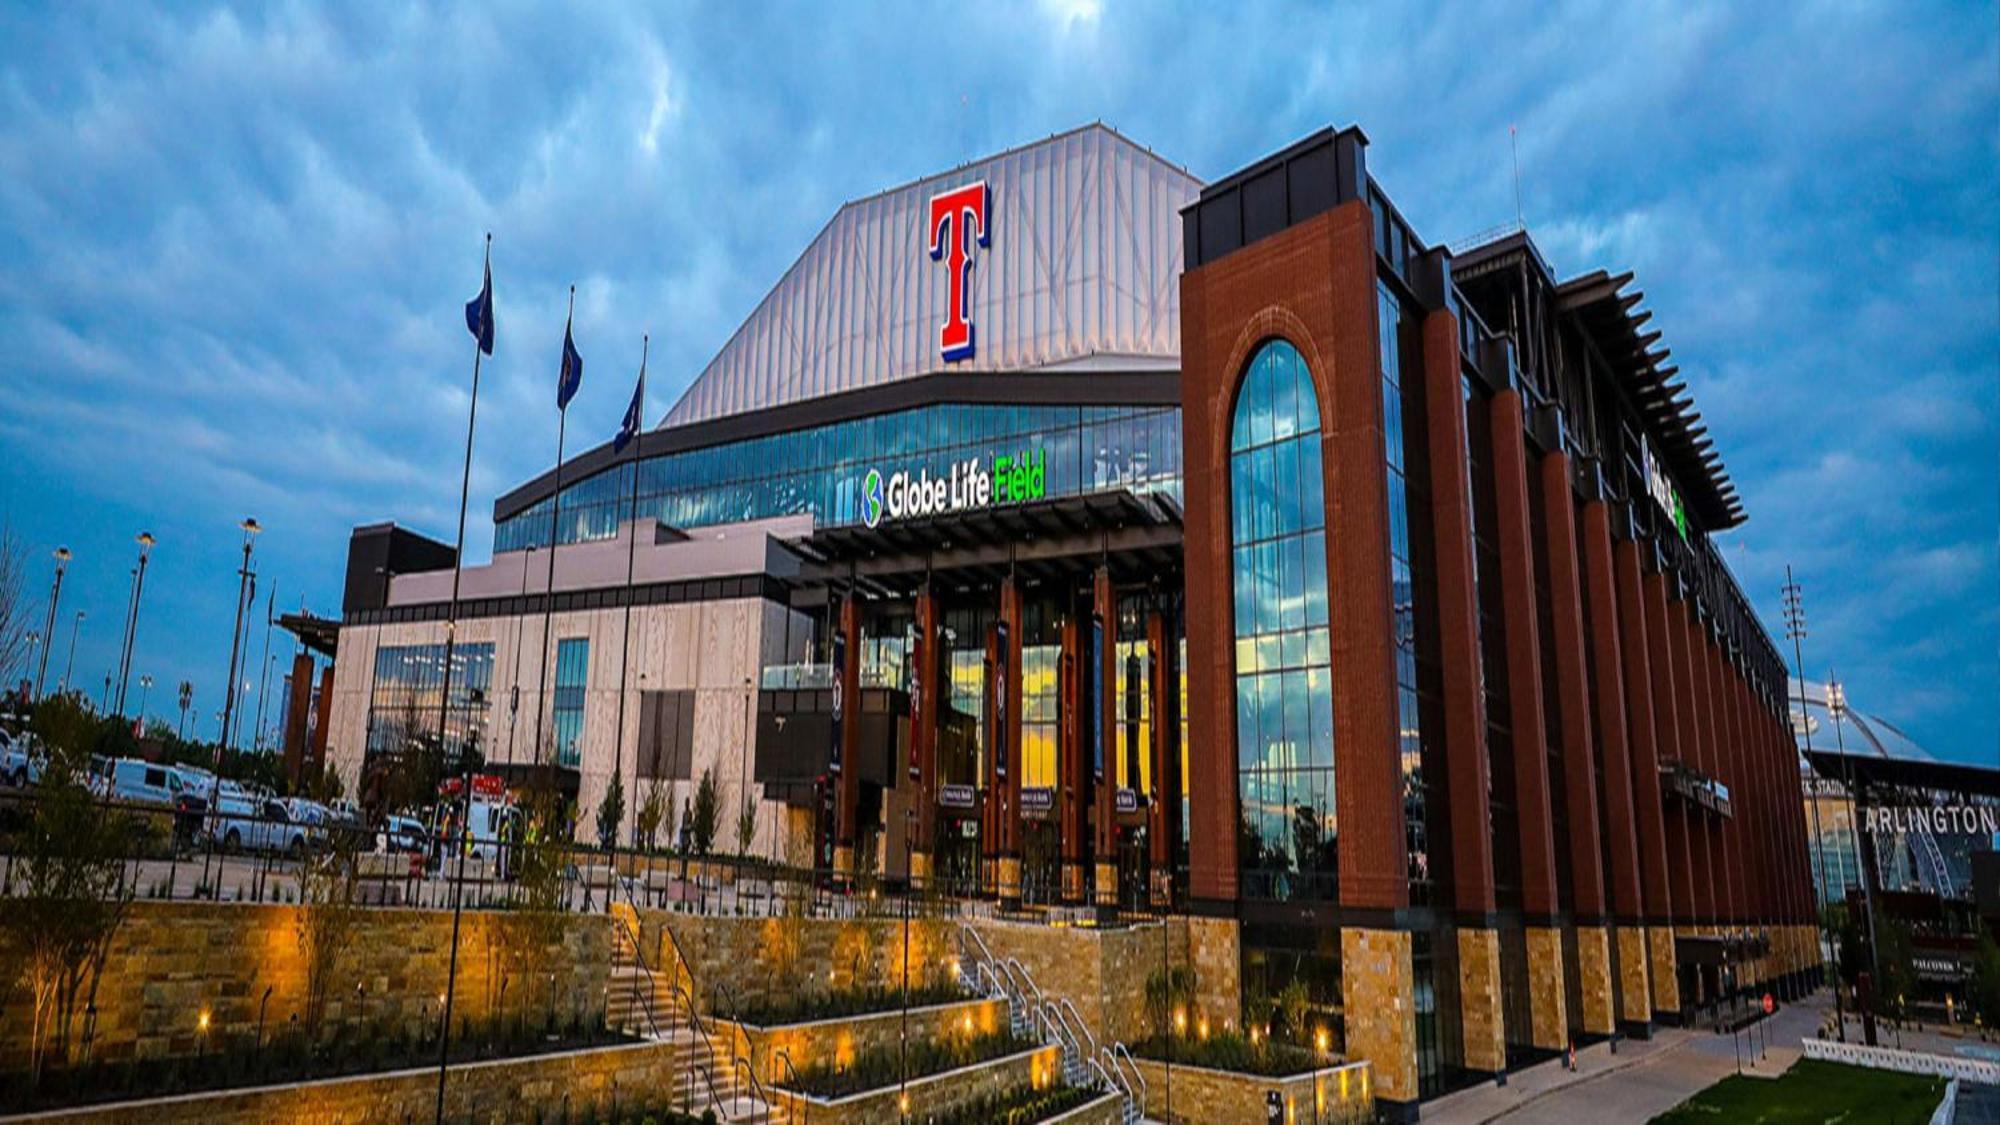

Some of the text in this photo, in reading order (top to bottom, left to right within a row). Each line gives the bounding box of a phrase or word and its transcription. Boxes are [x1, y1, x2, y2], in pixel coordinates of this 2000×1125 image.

[929, 180, 990, 361] T
[888, 448, 1045, 518] Globe Life Field
[1865, 806, 1997, 834] ARLINGTON
